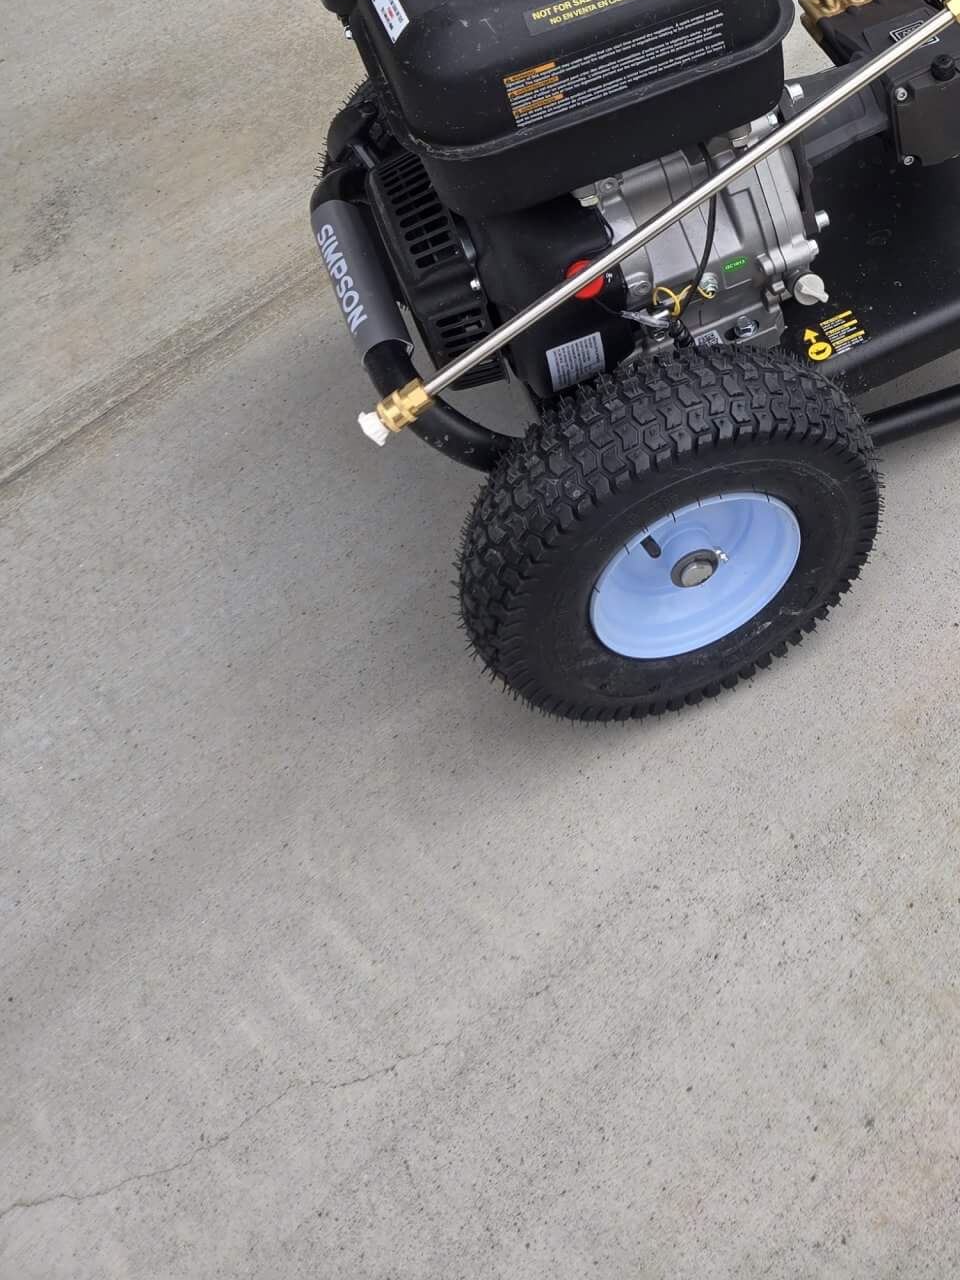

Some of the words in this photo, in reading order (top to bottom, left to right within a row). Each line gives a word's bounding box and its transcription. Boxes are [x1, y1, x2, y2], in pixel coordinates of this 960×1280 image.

[531, 8, 552, 20] NOT
[552, 1, 573, 14] FOR
[549, 15, 562, 25] NO
[562, 11, 574, 21] EN
[573, 3, 598, 18] VENTA
[597, 0, 609, 9] EN
[317, 224, 368, 334] SIMPSON
